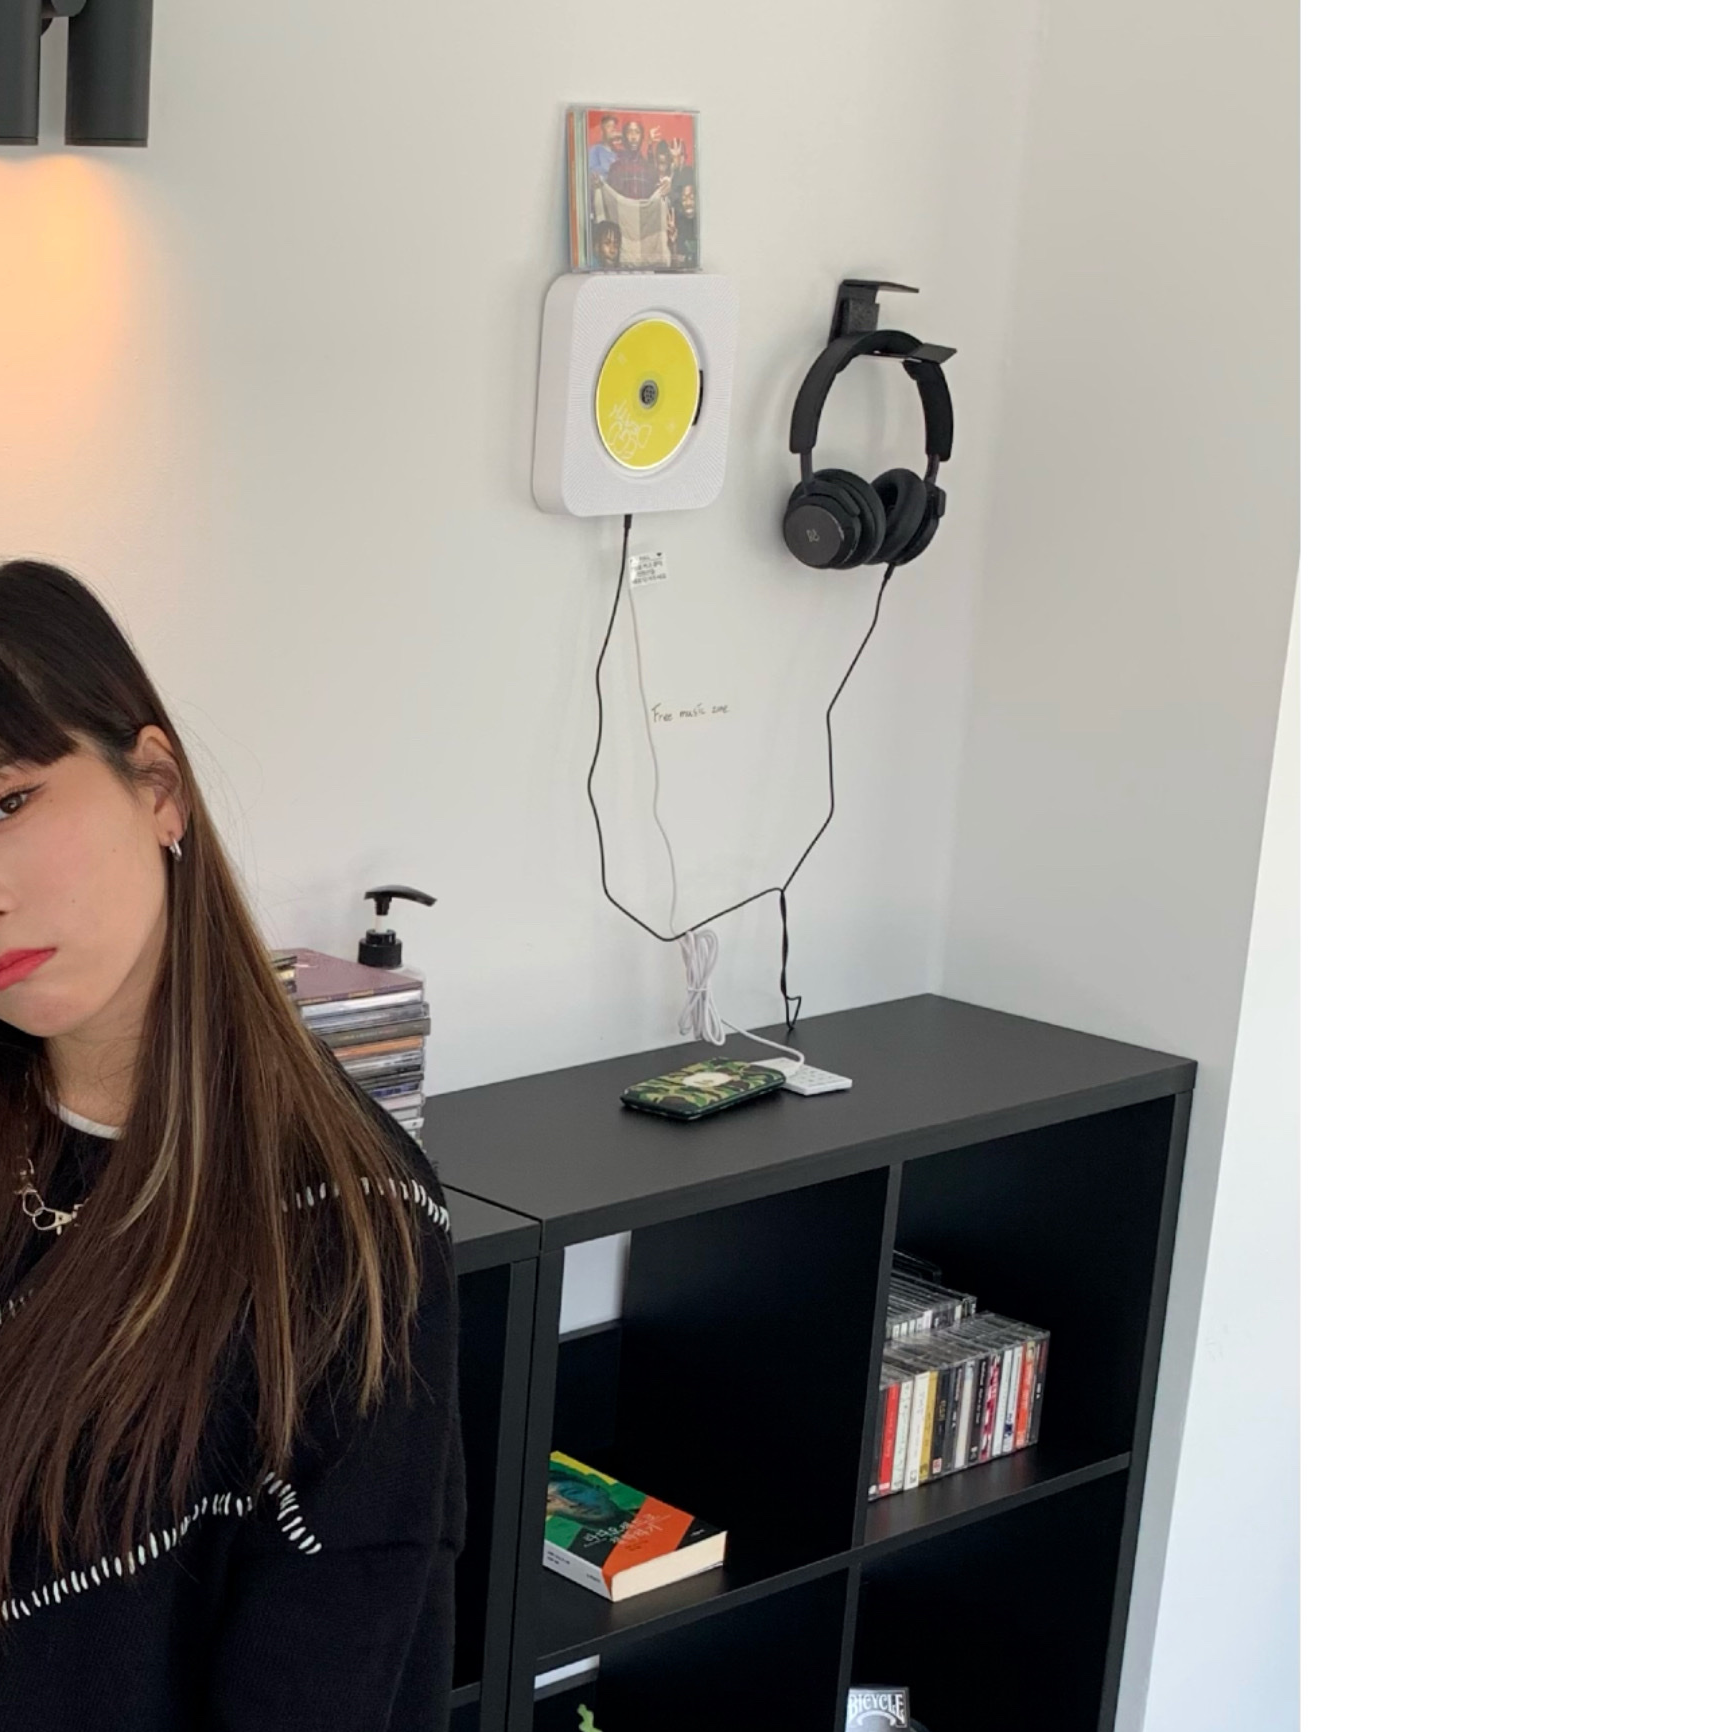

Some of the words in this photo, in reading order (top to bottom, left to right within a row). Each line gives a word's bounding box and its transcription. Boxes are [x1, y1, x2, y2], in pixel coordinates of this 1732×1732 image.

[651, 702, 673, 723] Free
[679, 703, 706, 718] music
[848, 1693, 905, 1723] BICYCLE
